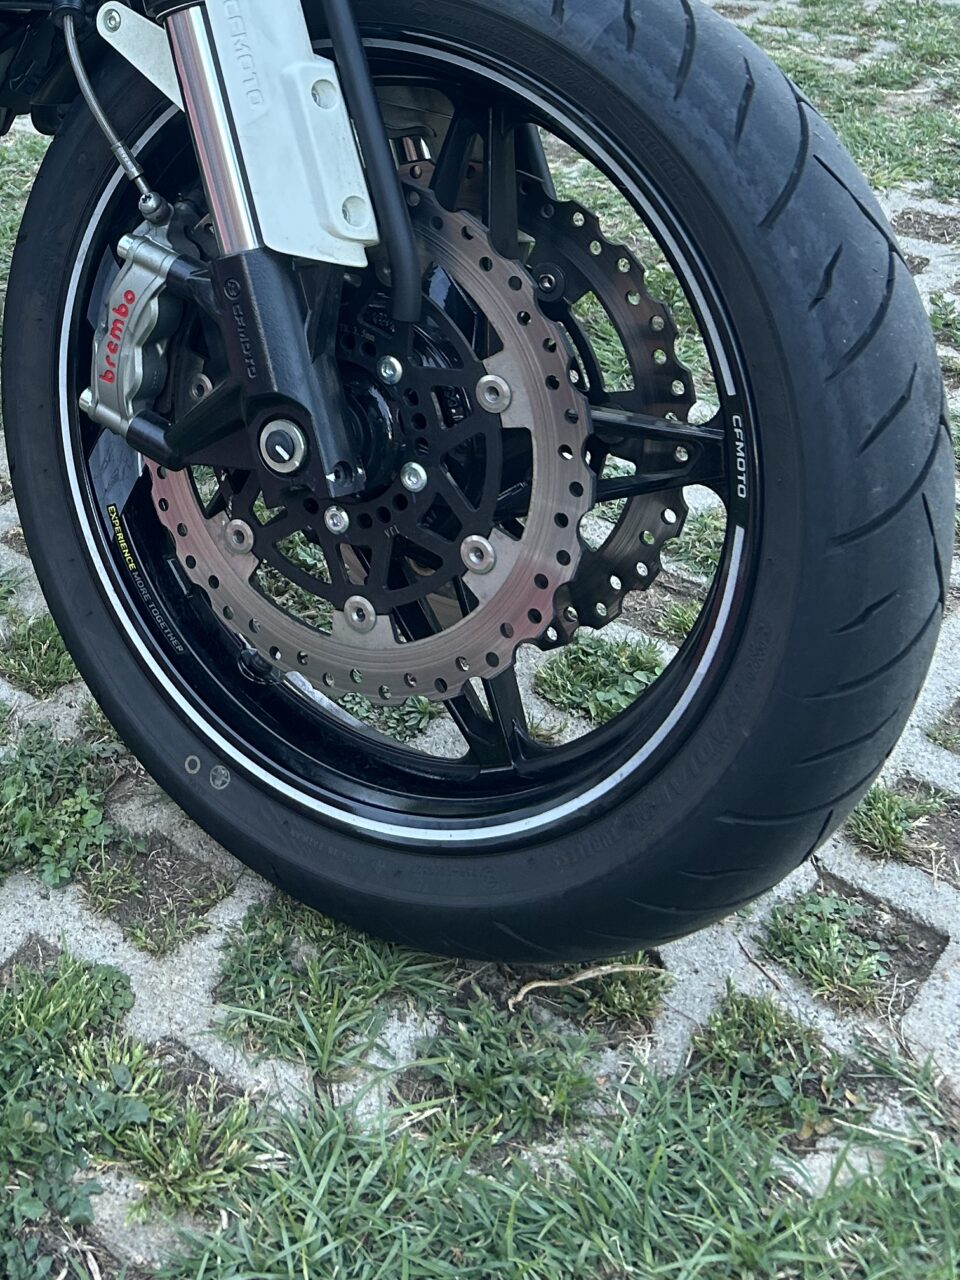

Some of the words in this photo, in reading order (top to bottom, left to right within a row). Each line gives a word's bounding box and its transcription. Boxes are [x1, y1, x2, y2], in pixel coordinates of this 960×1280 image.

[98, 289, 136, 385] brembo
[732, 414, 747, 499] CFMOTO
[107, 504, 137, 571] EXPERIENCE
[132, 571, 152, 602] MORE
[148, 601, 184, 653] TOGETHER
